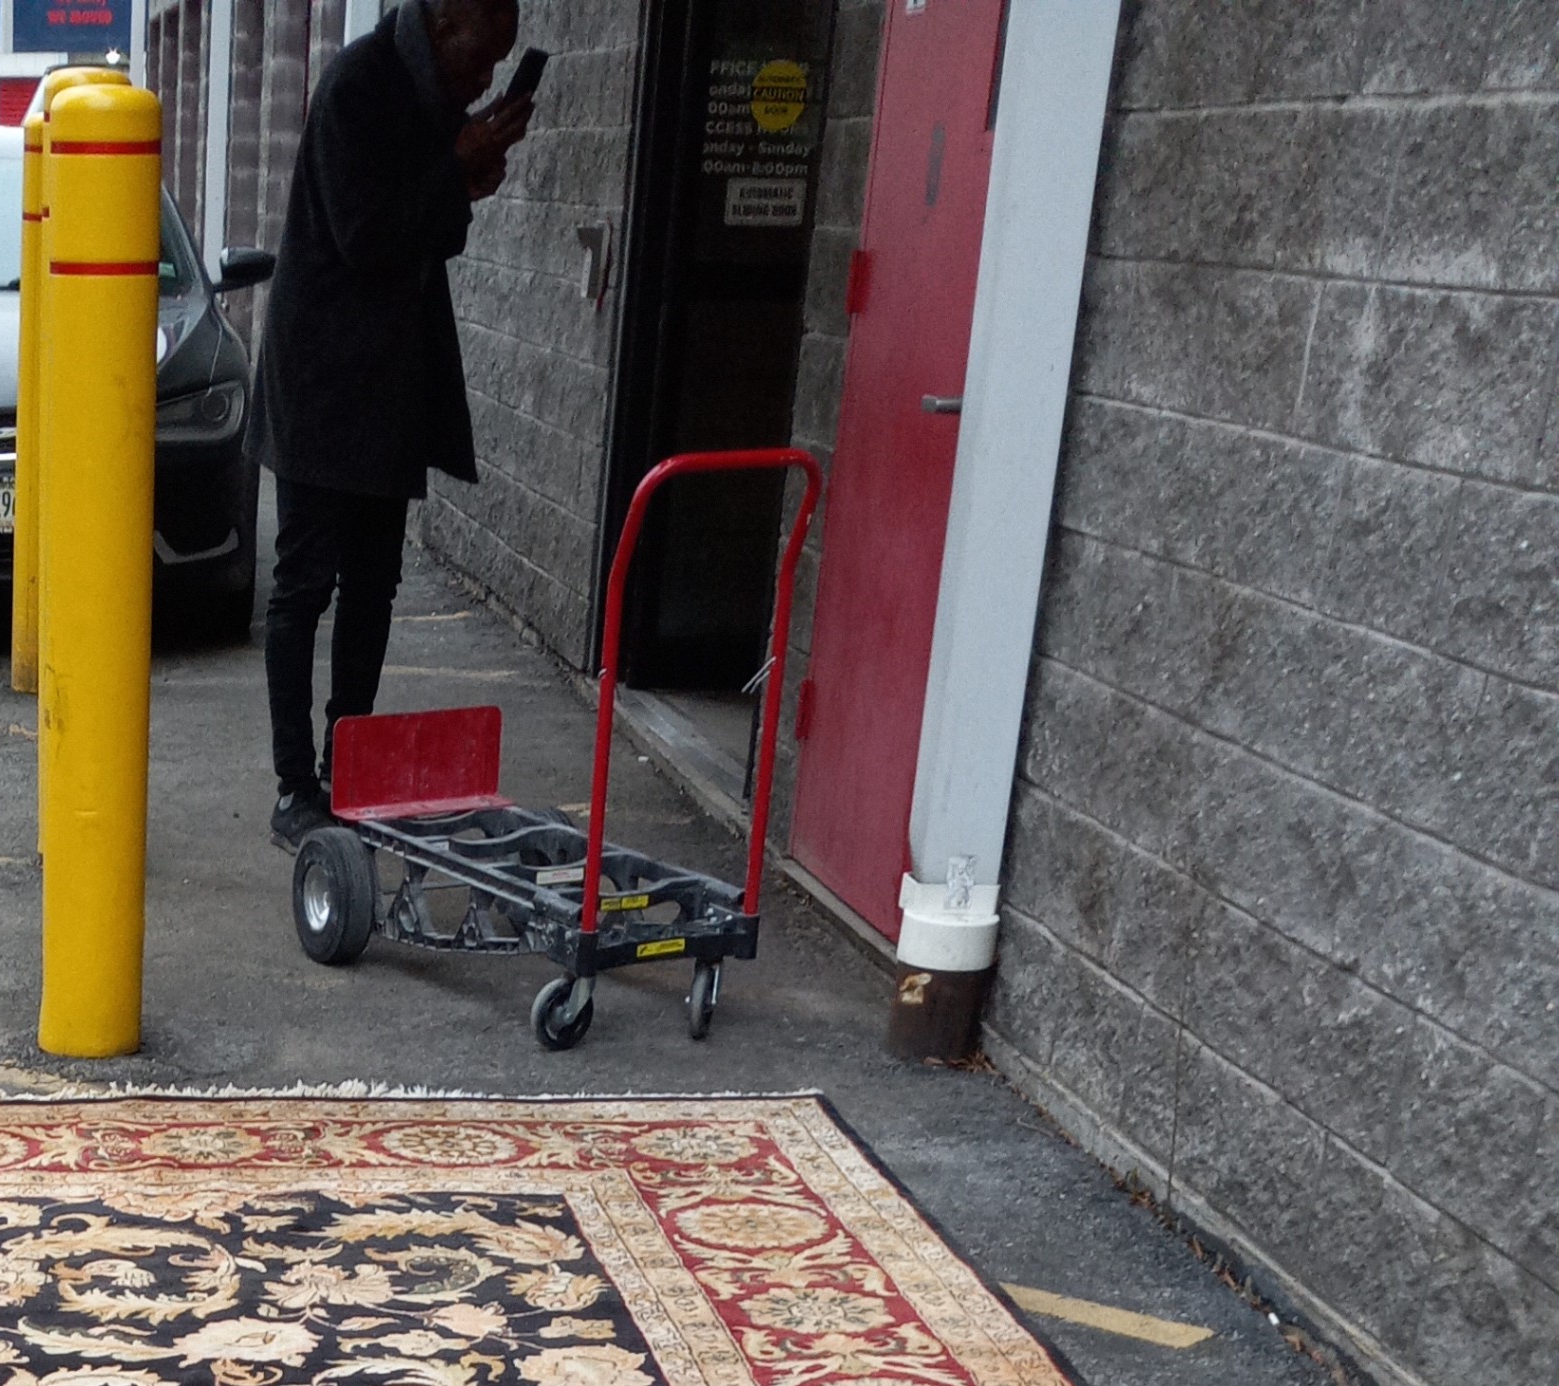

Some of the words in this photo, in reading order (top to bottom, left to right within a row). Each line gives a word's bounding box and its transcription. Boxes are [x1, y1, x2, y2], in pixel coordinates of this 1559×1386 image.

[710, 59, 756, 76] FFICE
[753, 86, 805, 102] CAUTION
[705, 120, 753, 135] CCESS
